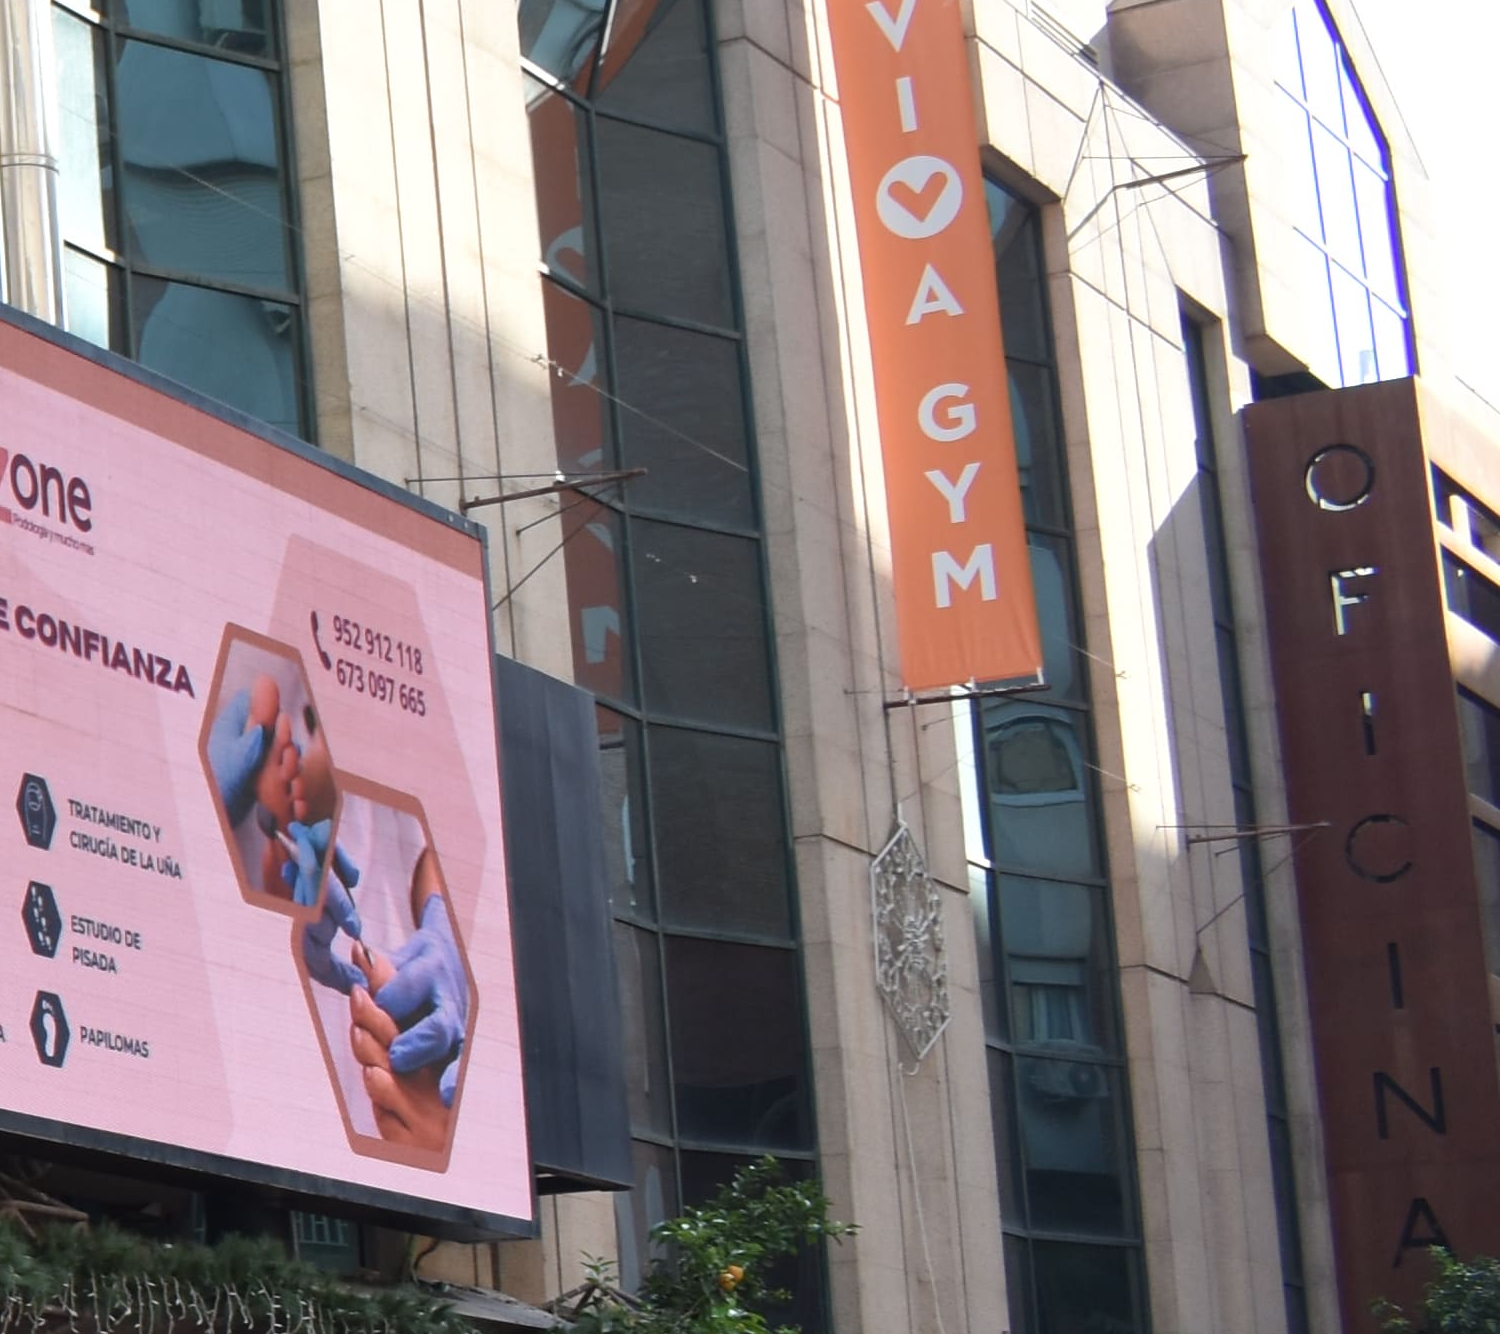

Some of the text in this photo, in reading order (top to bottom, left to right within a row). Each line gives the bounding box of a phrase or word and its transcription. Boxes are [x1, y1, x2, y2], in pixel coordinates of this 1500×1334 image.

[917, 383, 997, 609] GYM
[14, 605, 195, 699] CONFIANZA
[333, 615, 423, 675] 952 912 118
[336, 658, 426, 716] 673 097 665
[67, 798, 161, 843] TRATAMIENTO Y
[69, 831, 182, 880] CIRUGÍA DE LA UÑA
[70, 915, 141, 950] ESTUDIO DE
[72, 947, 117, 974] PISADA
[79, 1026, 149, 1058] PAPILOMAS
